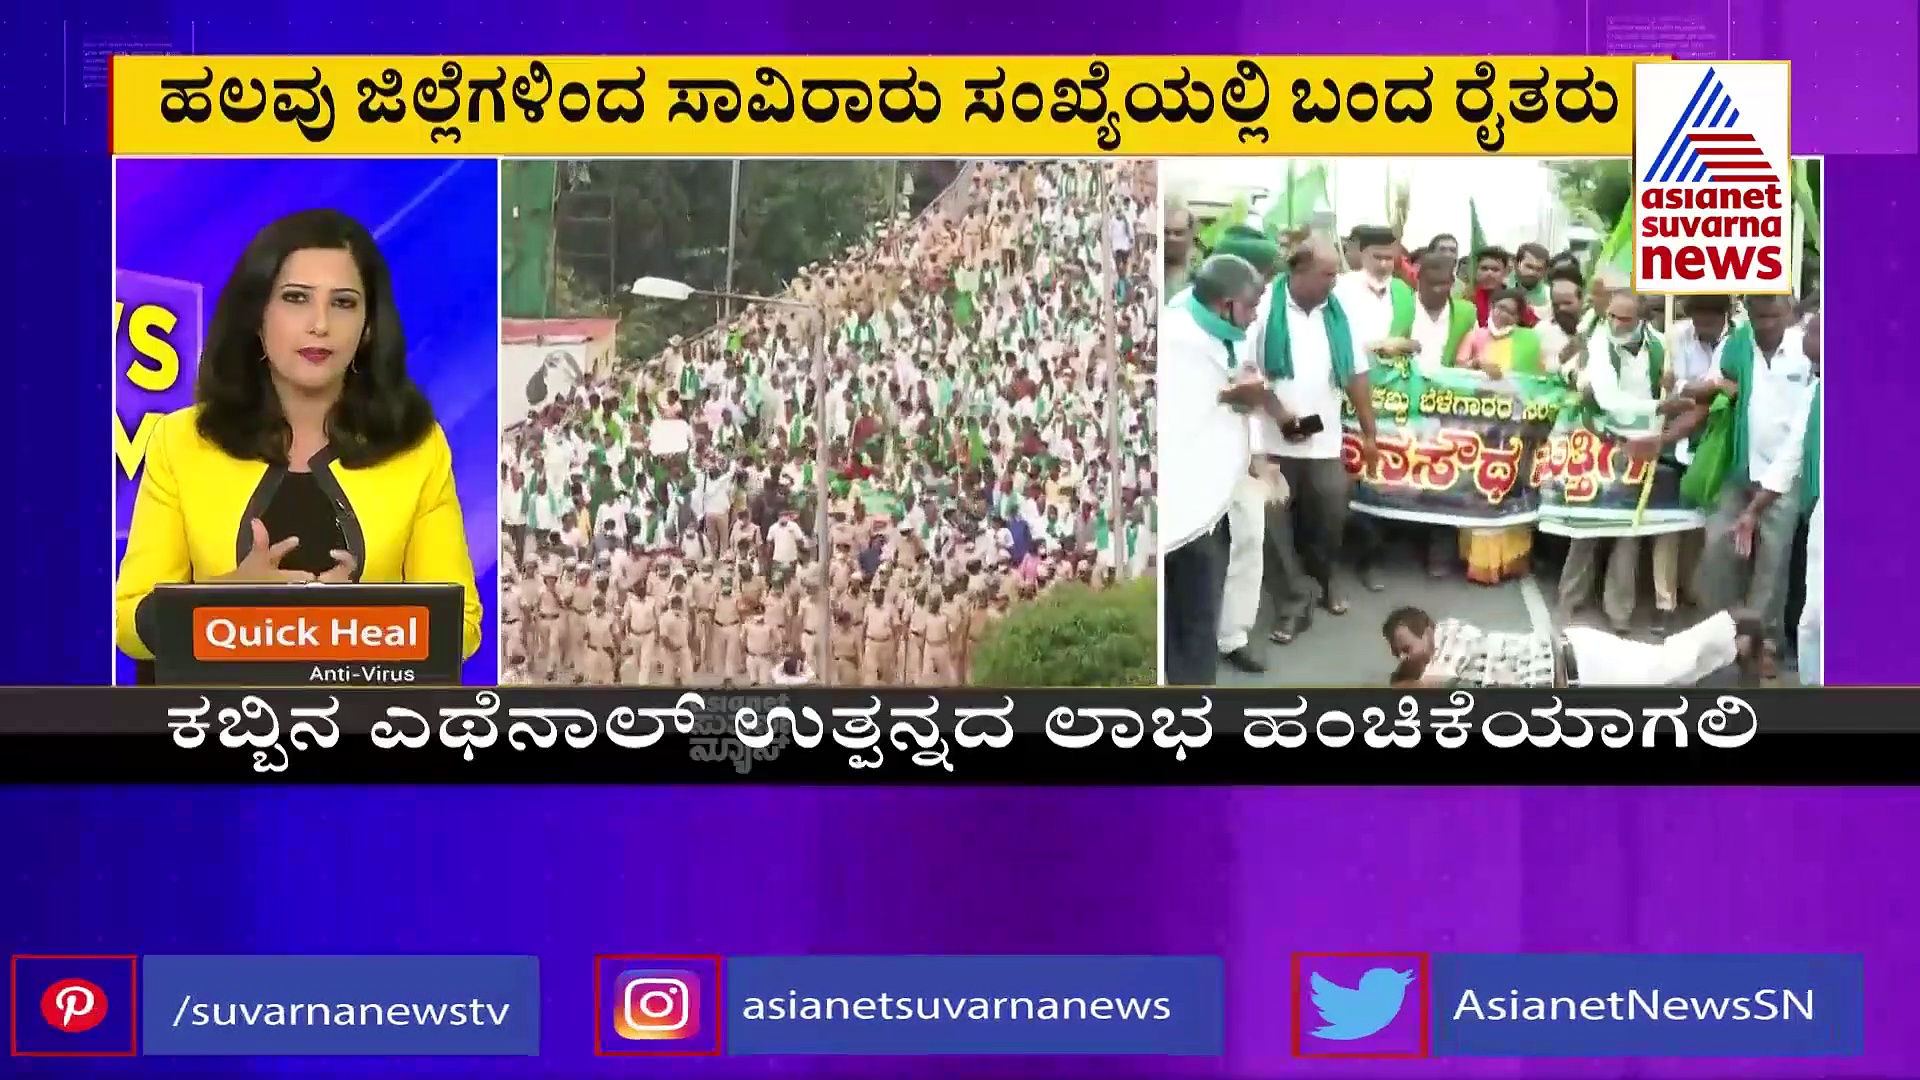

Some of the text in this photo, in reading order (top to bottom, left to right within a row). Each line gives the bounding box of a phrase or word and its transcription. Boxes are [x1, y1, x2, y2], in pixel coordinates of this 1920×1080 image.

[206, 617, 417, 649] Quick Heal
[309, 665, 415, 683] Anti-Virus
